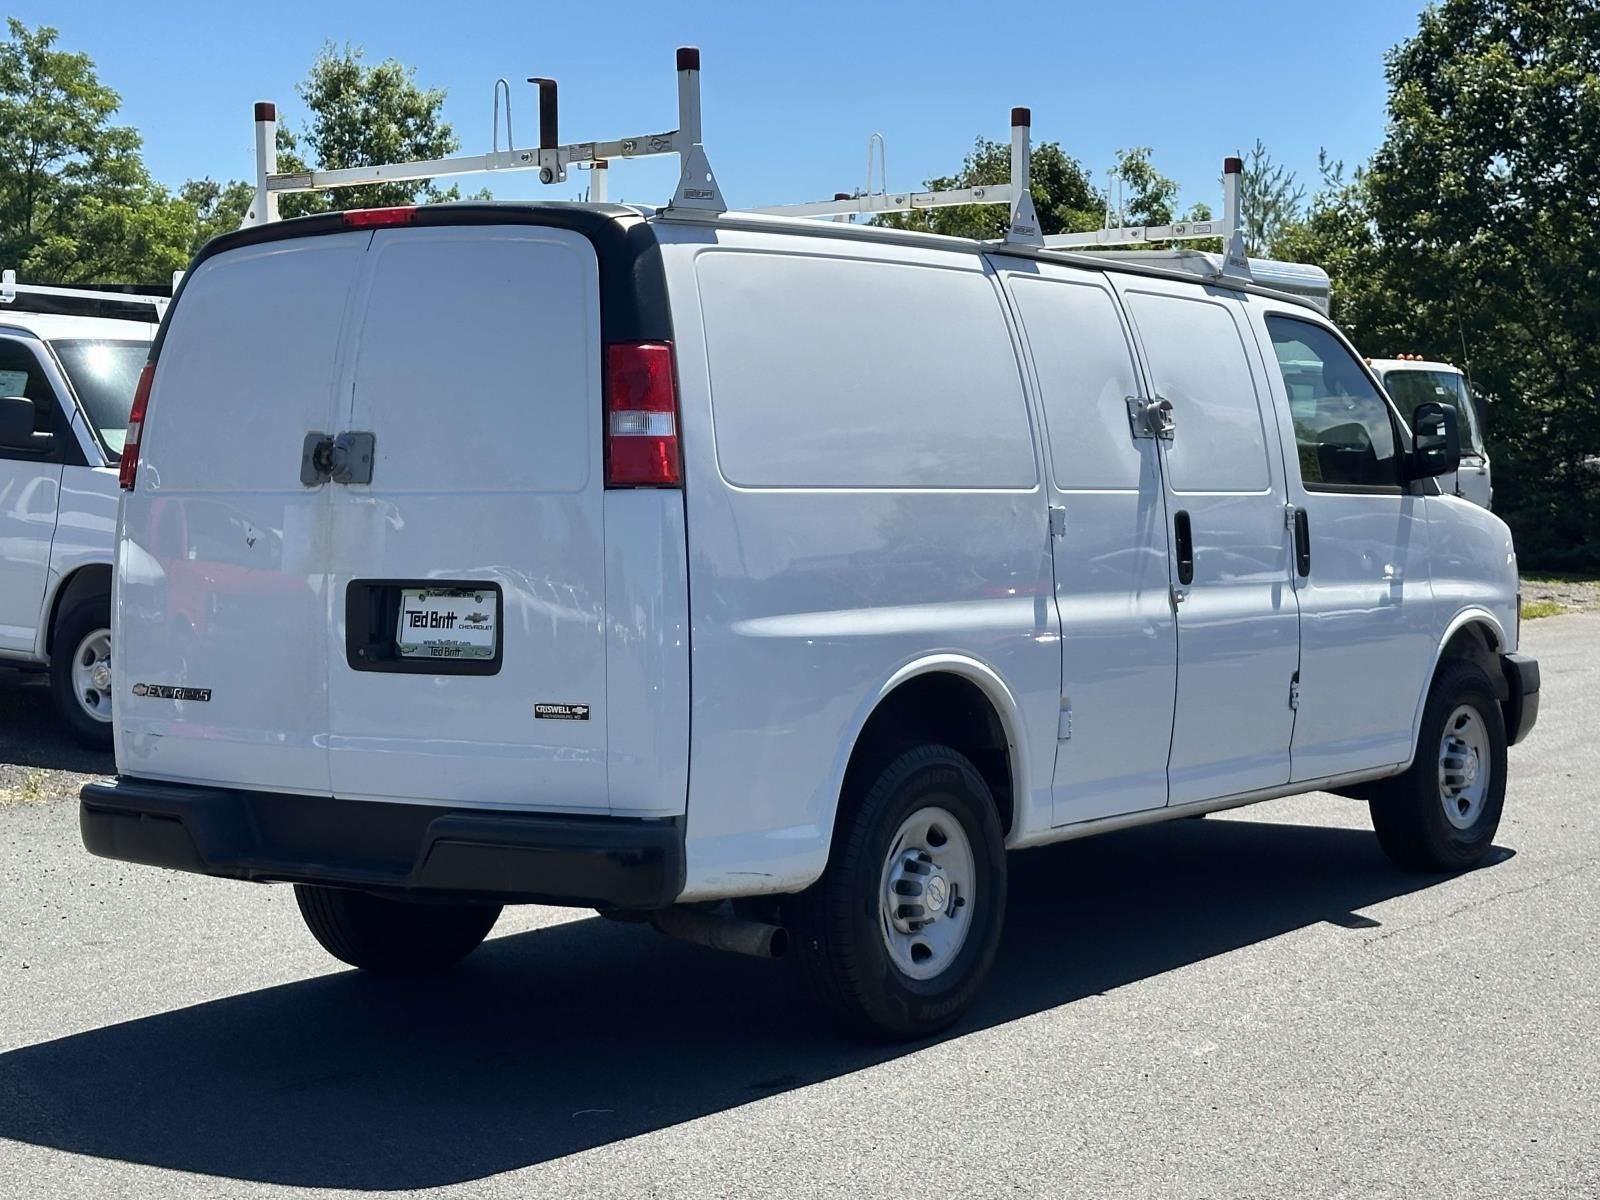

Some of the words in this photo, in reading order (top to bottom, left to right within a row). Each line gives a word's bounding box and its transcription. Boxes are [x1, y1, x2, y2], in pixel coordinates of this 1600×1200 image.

[406, 610, 429, 628] Ted
[430, 611, 458, 629] Britt
[428, 646, 443, 656] Ted
[444, 647, 463, 657] Britt
[535, 705, 571, 714] CRISWELL
